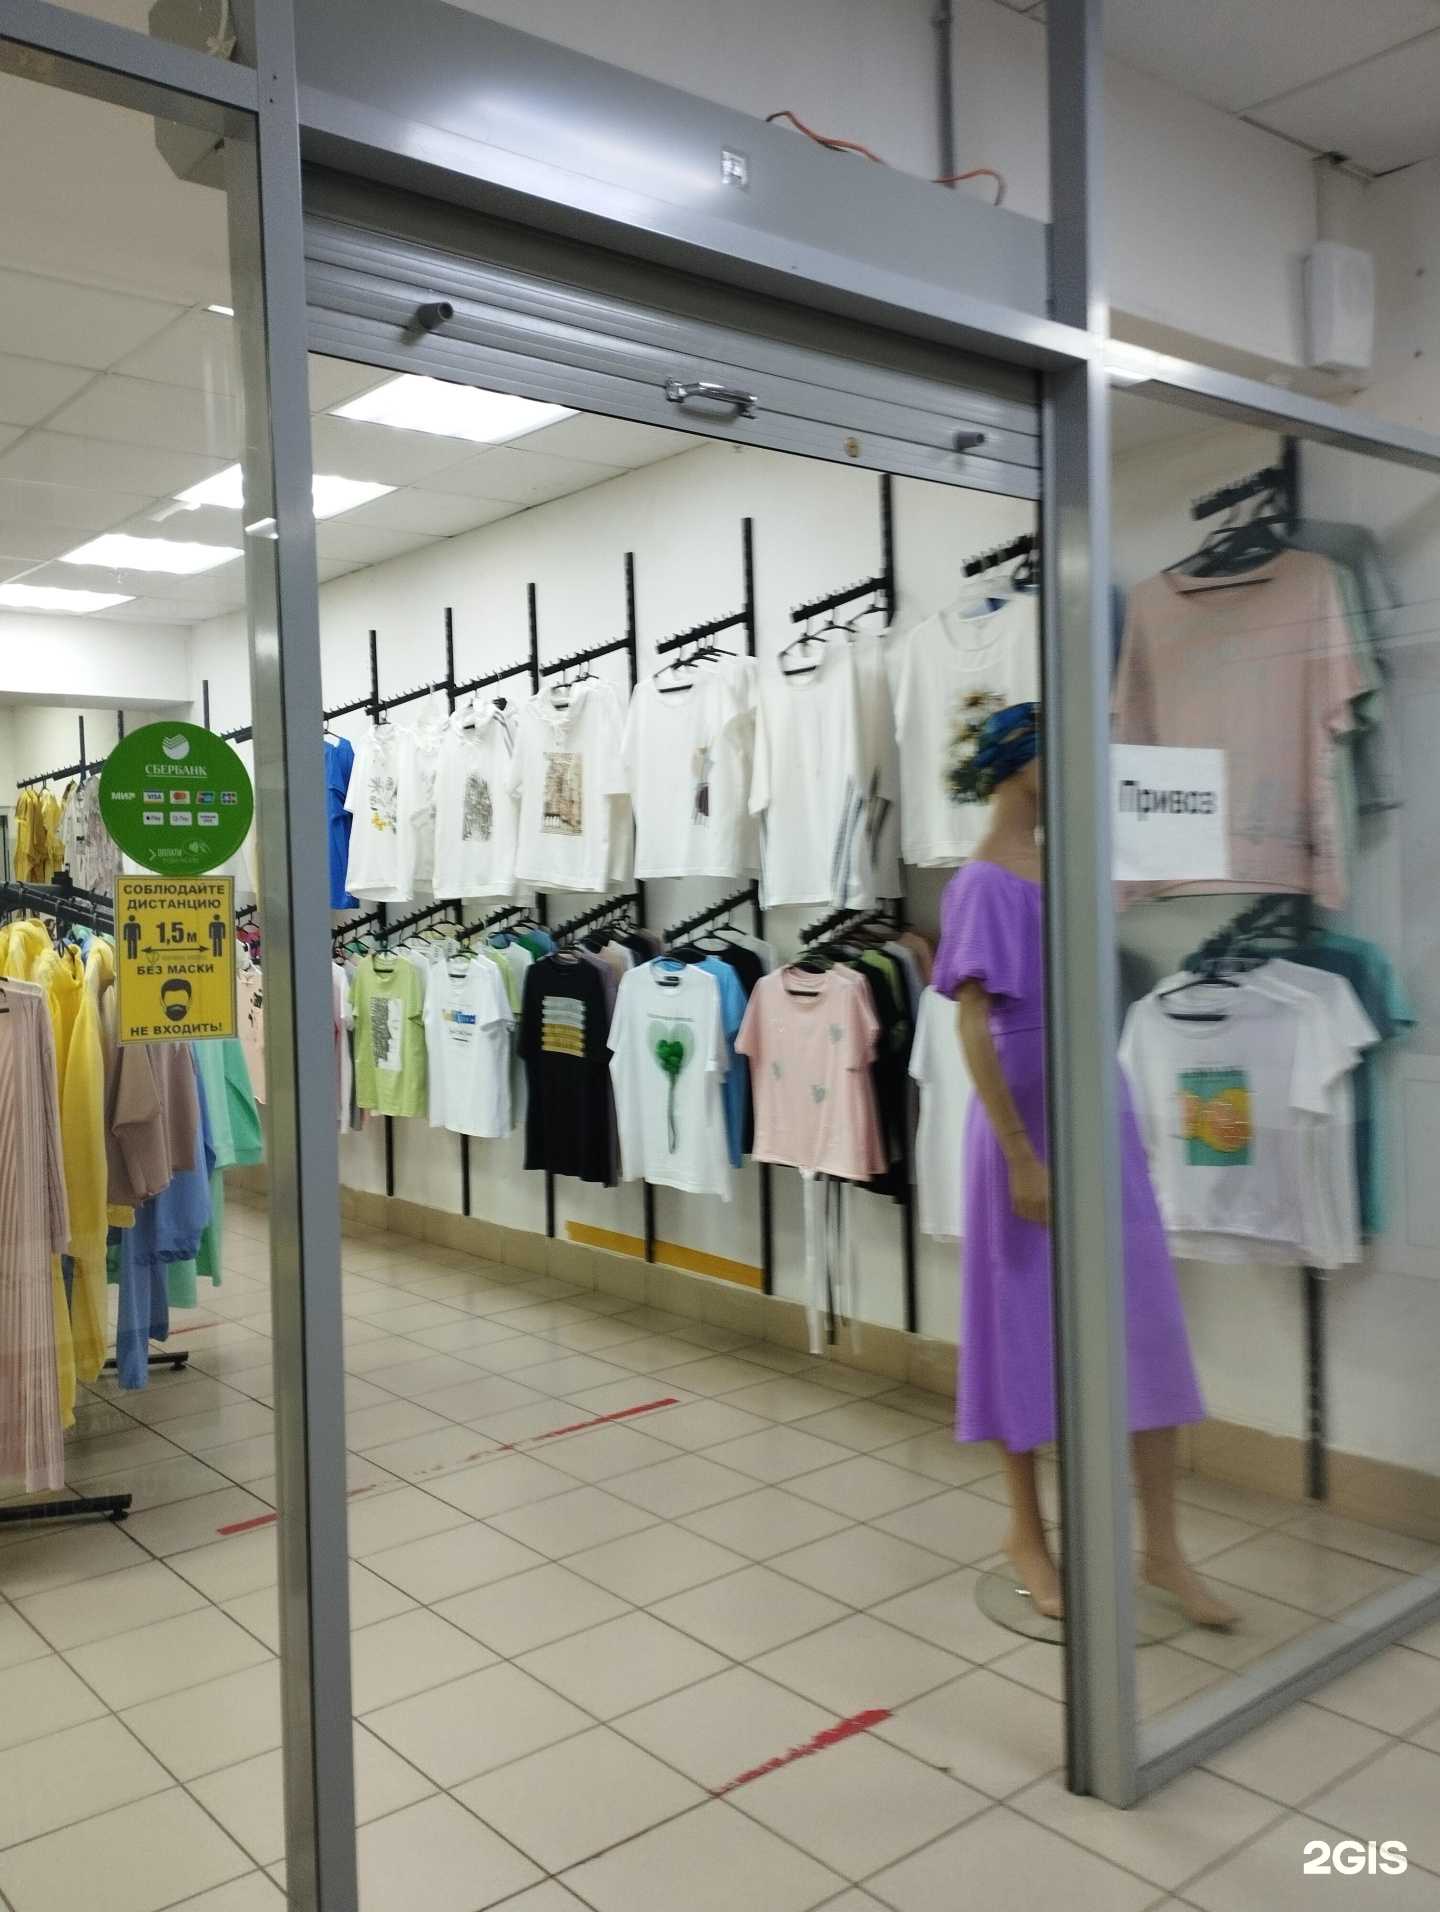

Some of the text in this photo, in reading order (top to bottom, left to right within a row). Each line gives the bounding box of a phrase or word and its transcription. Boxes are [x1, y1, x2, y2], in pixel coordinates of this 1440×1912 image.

[145, 764, 207, 776] СБЕРБАНК
[1119, 780, 1216, 820] Привоз
[123, 884, 225, 895] СОБЛЮДАЙТЕ
[127, 899, 221, 910] ДИСТАНЦИЮ
[156, 921, 184, 945] 1,5
[136, 963, 214, 975] БЕЗ МАСКИ
[130, 1022, 223, 1036] НЕ ВХОДИТЬ!
